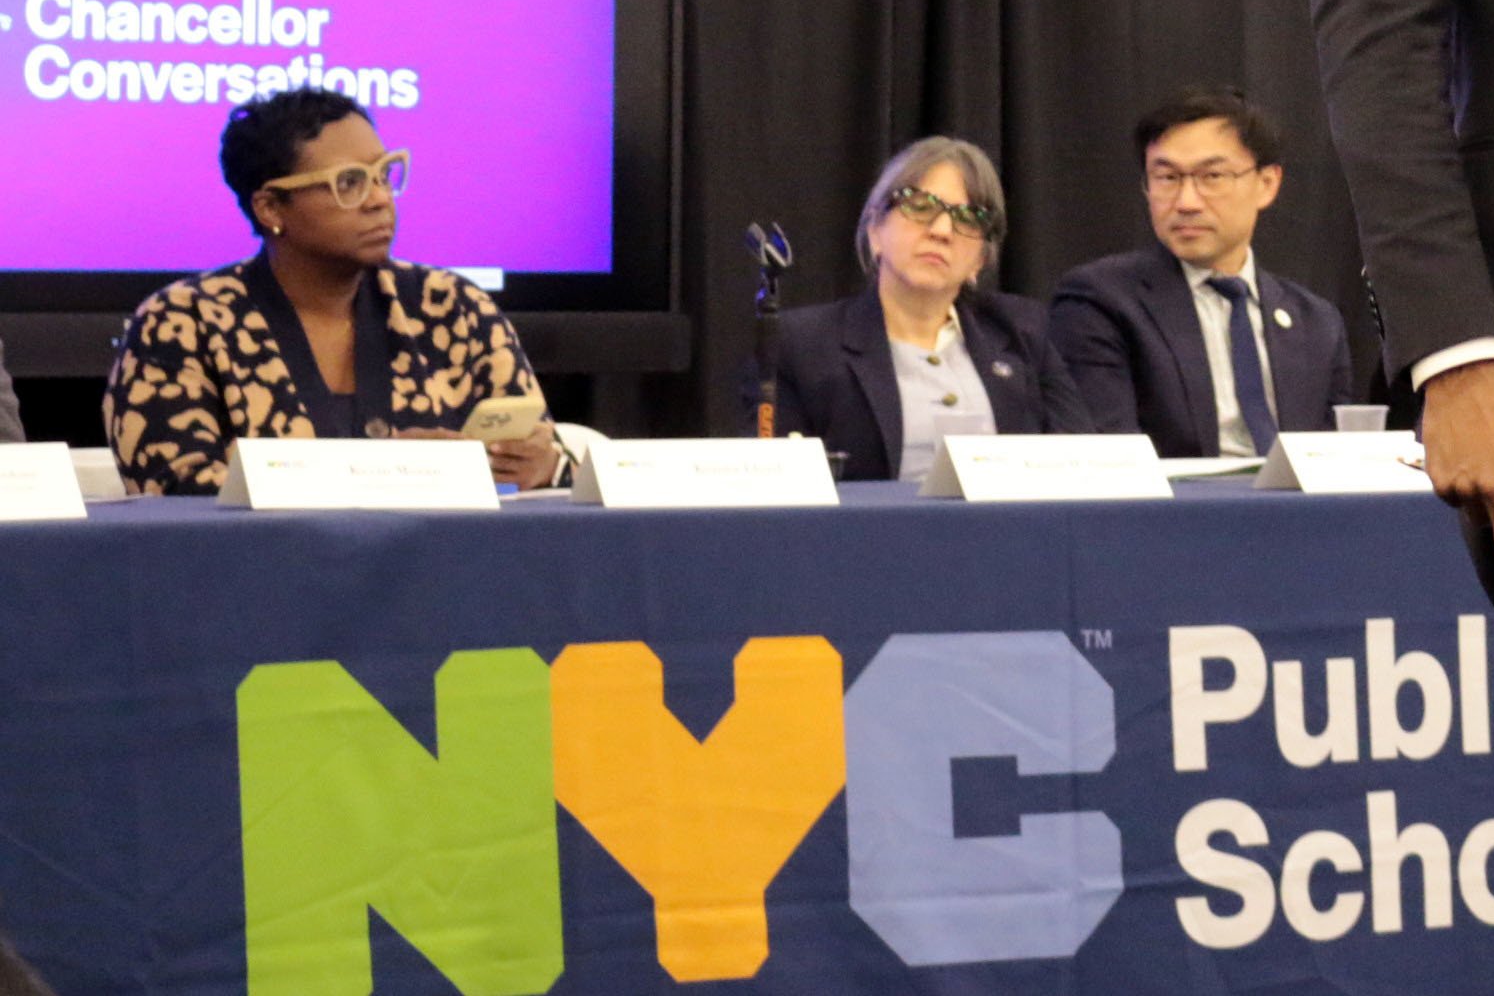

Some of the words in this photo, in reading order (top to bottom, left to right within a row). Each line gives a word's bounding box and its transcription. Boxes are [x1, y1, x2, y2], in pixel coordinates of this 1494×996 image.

[24, 44, 419, 108] Conversations
[236, 629, 1125, 996] NYC
[1081, 629, 1112, 649] TM
